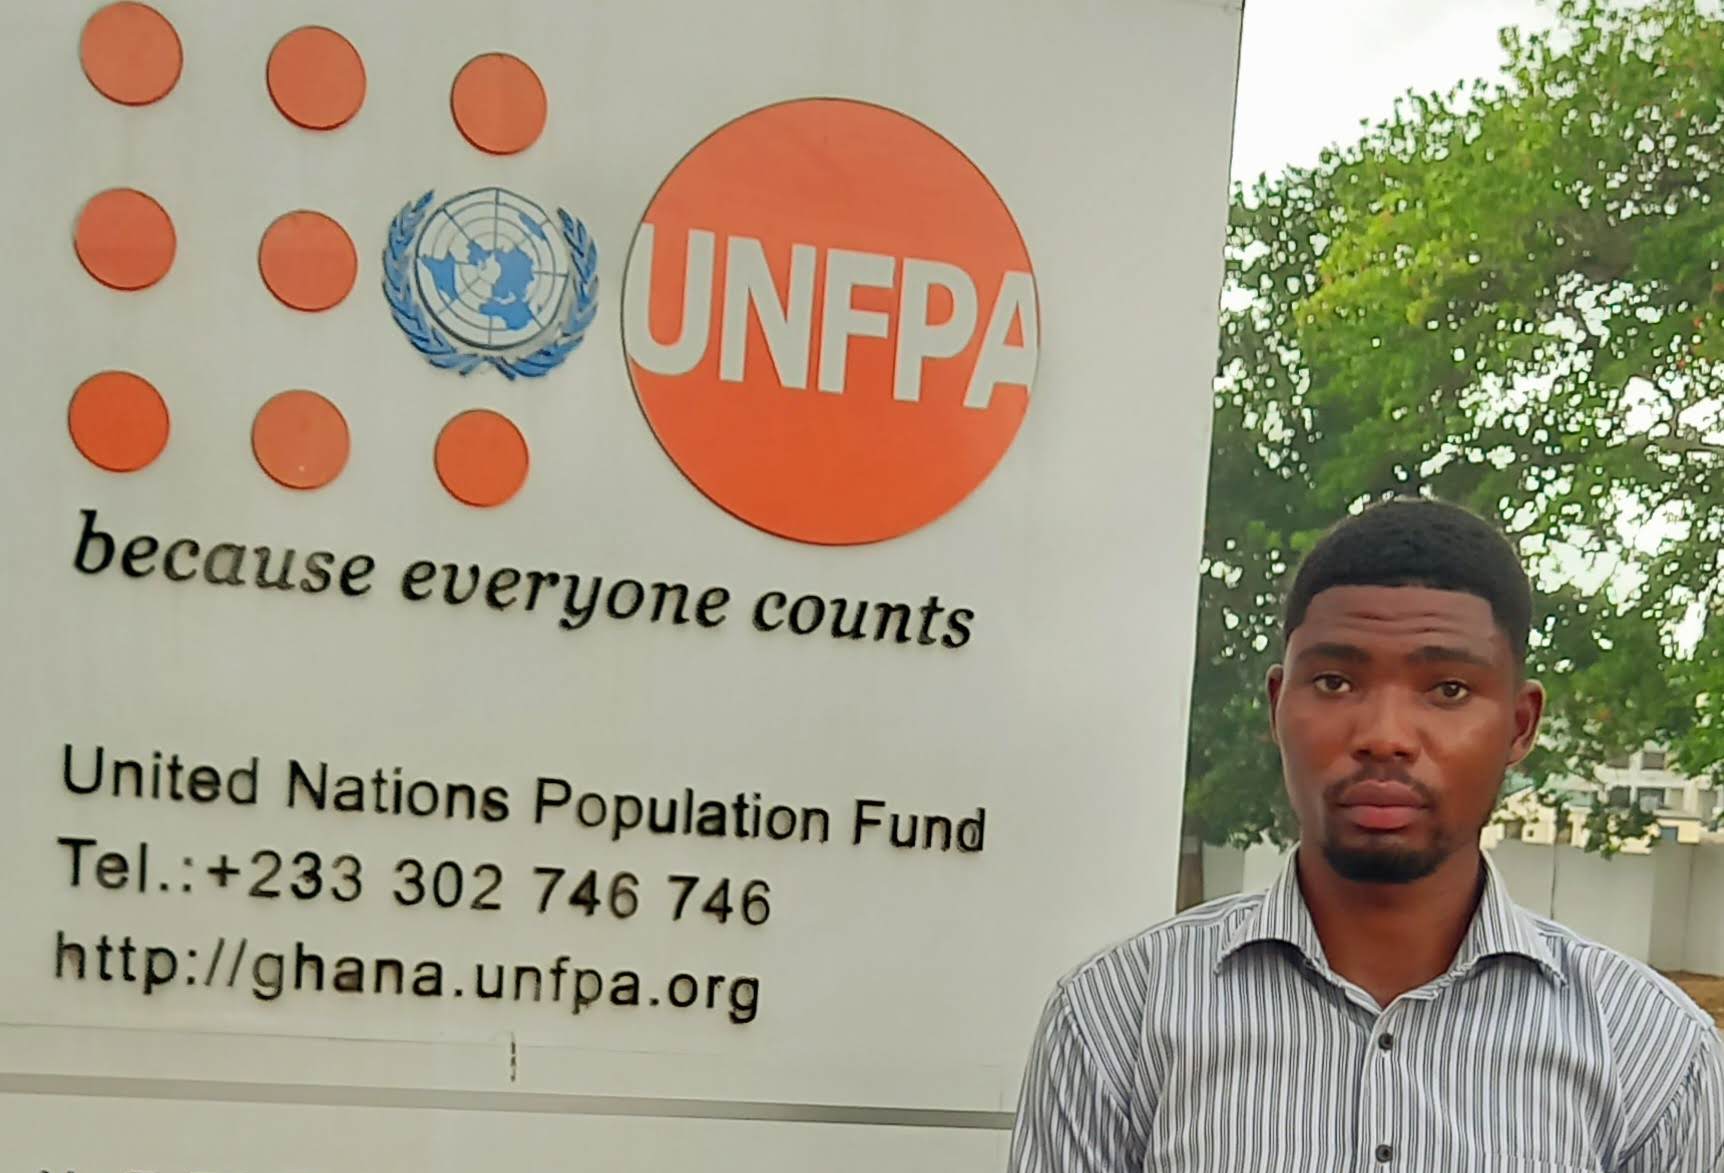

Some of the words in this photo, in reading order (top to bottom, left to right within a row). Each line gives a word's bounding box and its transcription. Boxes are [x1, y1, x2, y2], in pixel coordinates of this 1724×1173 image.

[622, 221, 1039, 409] UNFPA
[73, 508, 376, 598] because
[400, 558, 731, 632] everyone
[752, 591, 975, 649] counts
[62, 743, 260, 807] United
[286, 759, 511, 824] Nations
[533, 777, 831, 844] Population
[851, 799, 986, 854] Fund
[392, 857, 504, 912] 302
[532, 865, 640, 921] 746
[667, 874, 772, 928] 746
[54, 929, 761, 1026] http://ghana.unfpa.org
